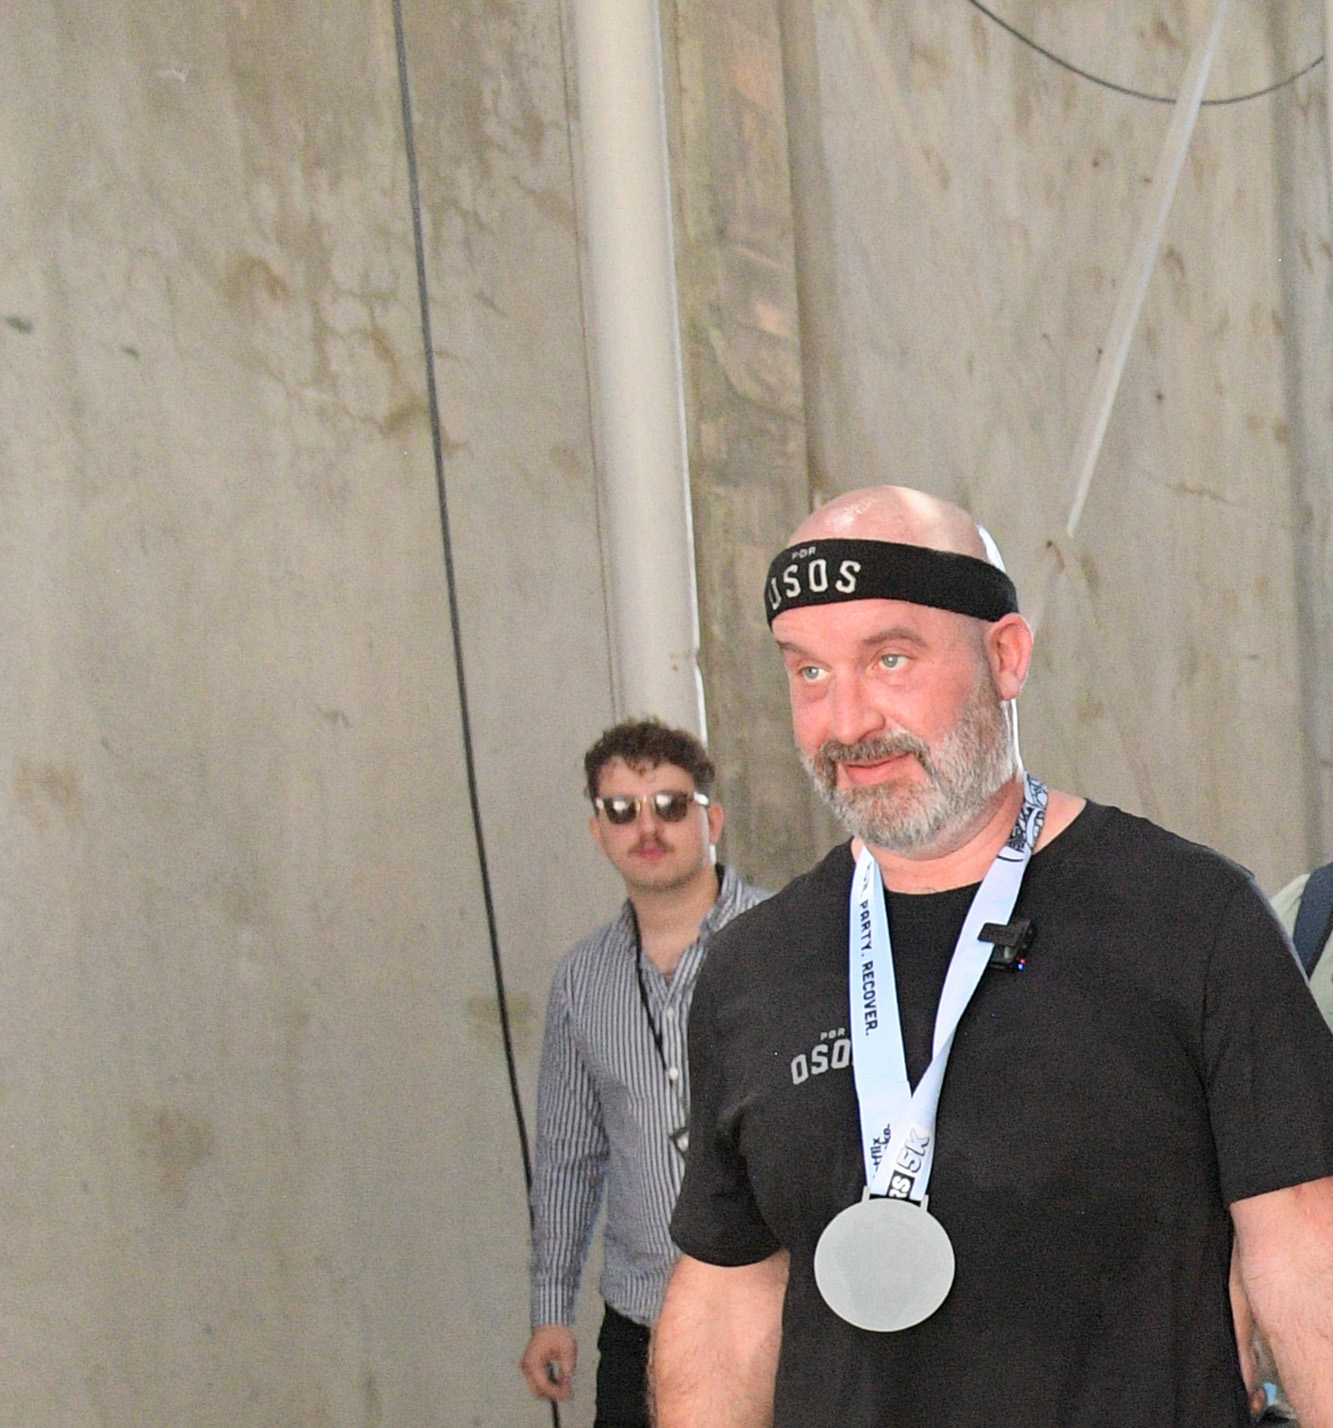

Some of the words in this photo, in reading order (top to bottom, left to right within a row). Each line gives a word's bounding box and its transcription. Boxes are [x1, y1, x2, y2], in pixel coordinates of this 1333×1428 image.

[859, 899, 873, 957] PARTY.
[861, 960, 879, 1037] RECOVER.
[790, 1038, 851, 1086] OSO
[896, 1127, 931, 1174] 5K
